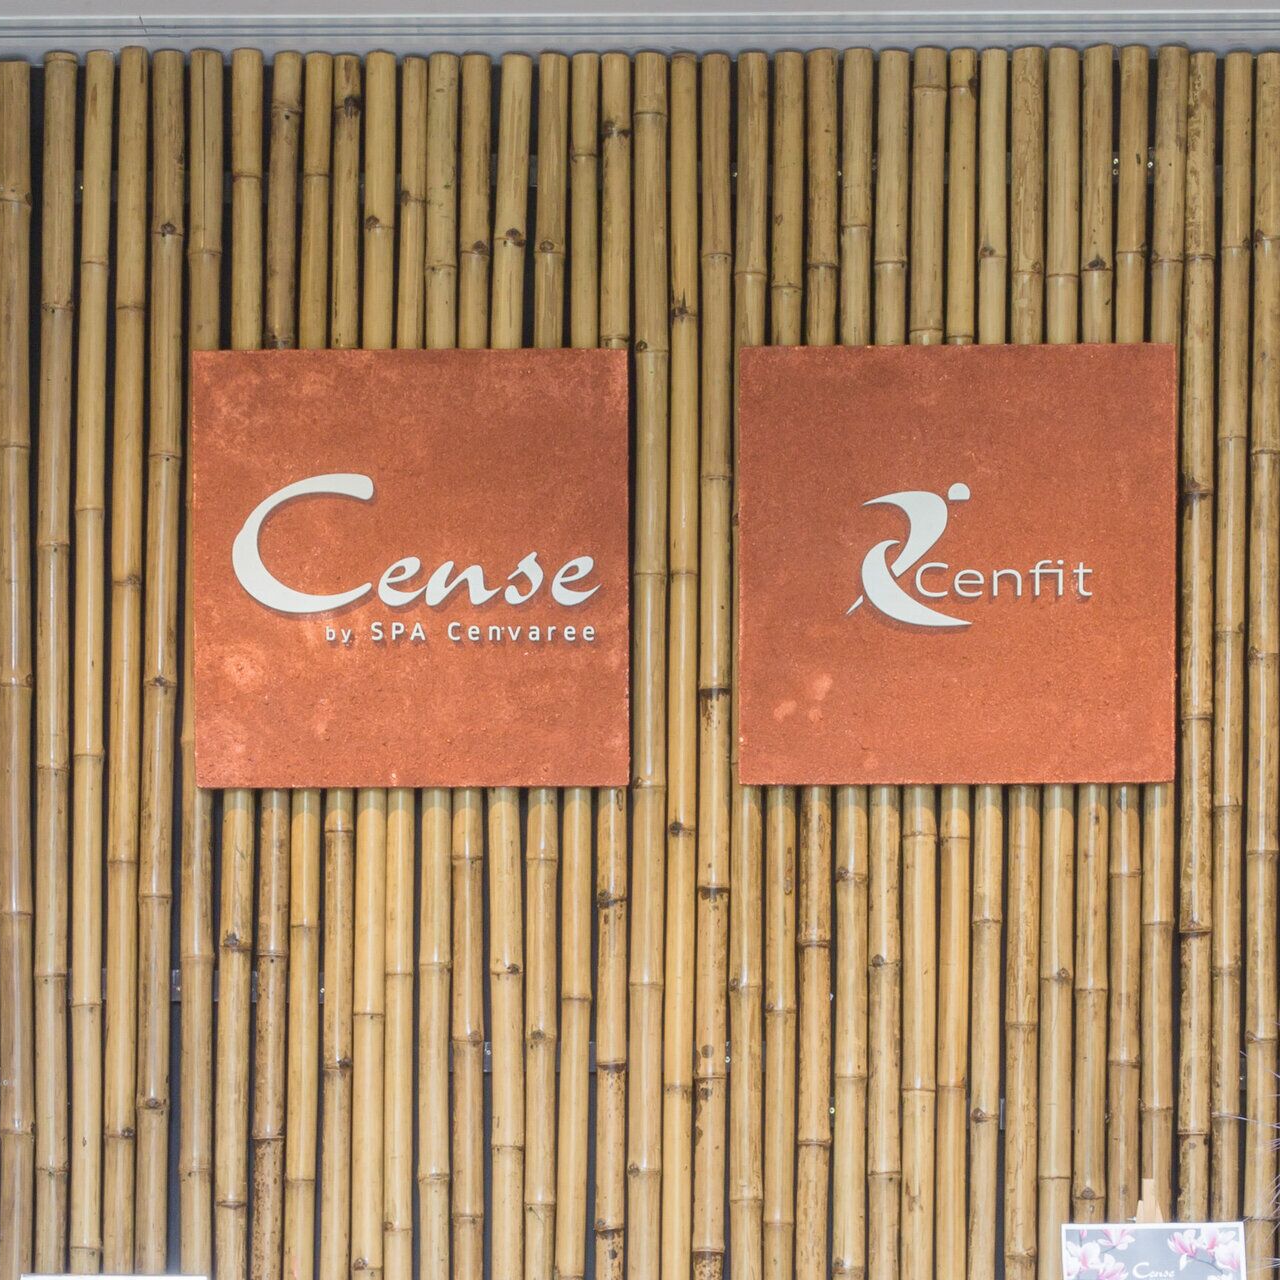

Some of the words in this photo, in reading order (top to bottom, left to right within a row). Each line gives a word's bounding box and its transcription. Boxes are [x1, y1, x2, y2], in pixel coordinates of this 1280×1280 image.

[231, 472, 602, 614] Cense
[914, 559, 1094, 599] Cenfit
[325, 625, 352, 647] by
[370, 621, 427, 642] SPA
[447, 621, 596, 643] Cenvaree
[1132, 1261, 1176, 1279] Cense
